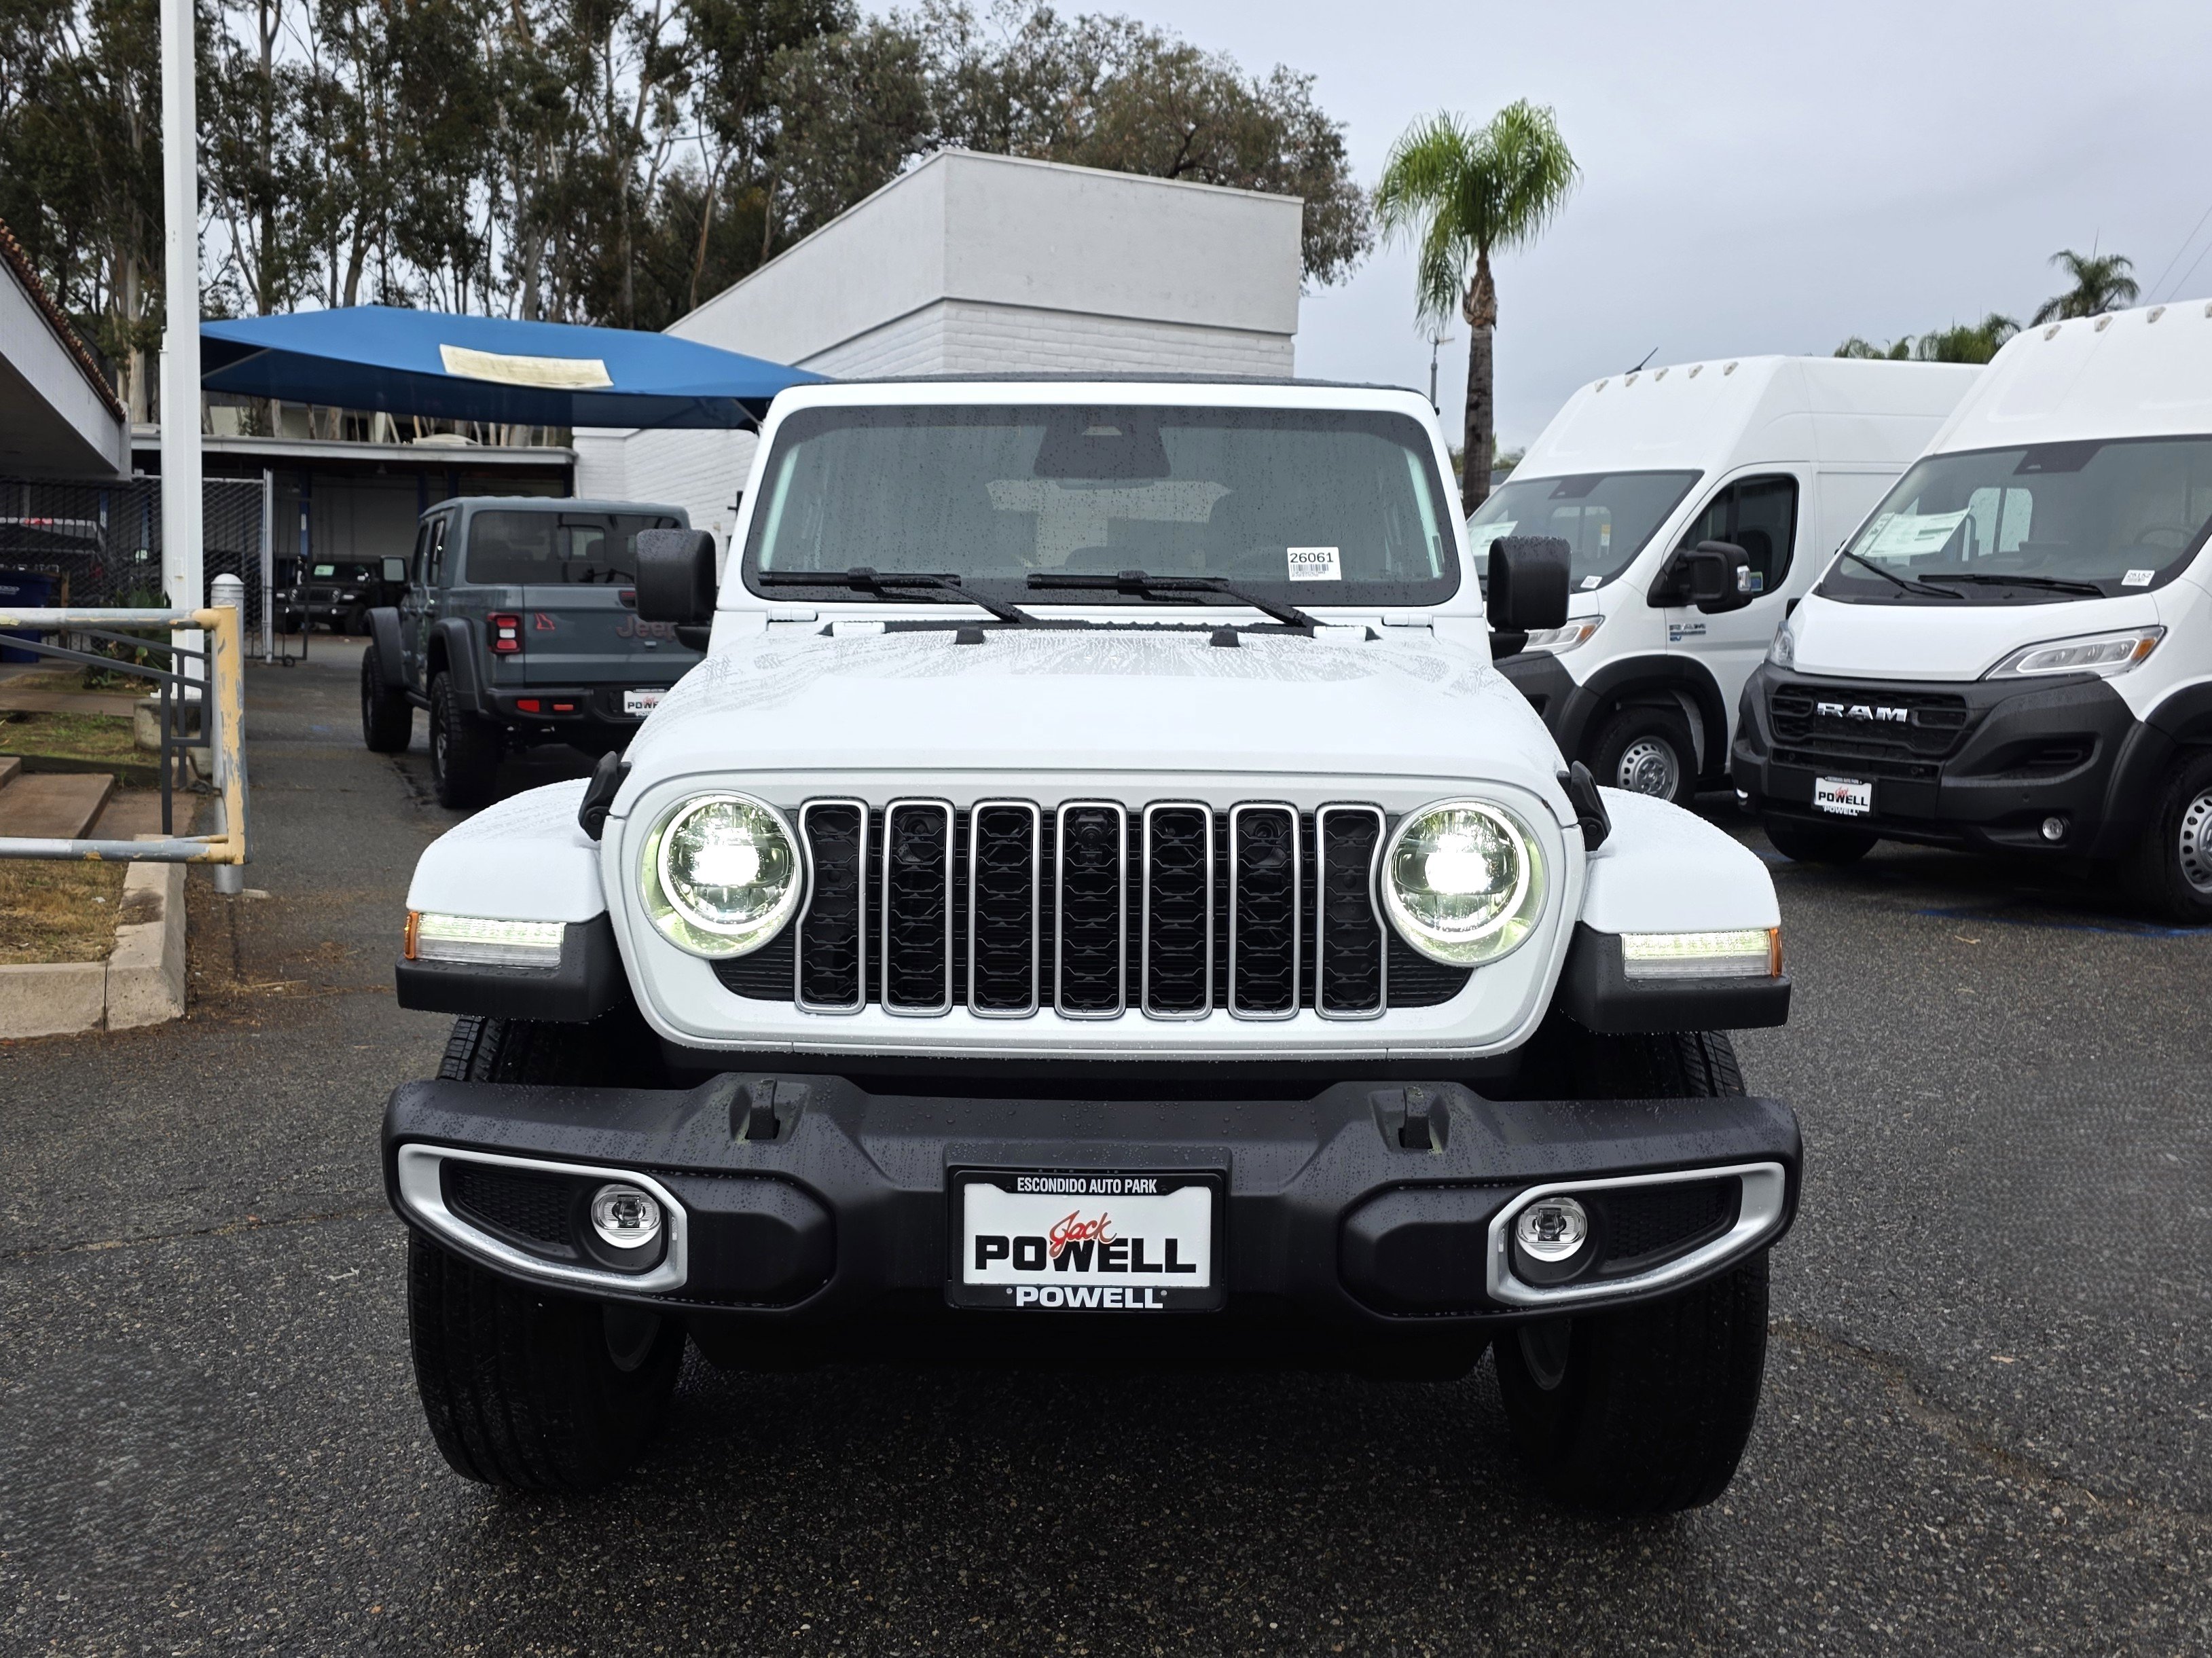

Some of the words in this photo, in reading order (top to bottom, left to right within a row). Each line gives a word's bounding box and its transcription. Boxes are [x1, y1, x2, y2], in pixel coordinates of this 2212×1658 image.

[1290, 553, 1334, 563] 26061
[1817, 702, 1908, 722] RAM
[1819, 791, 1868, 807] POWELL
[1017, 1177, 1086, 1193] ESCONDIDO
[1089, 1179, 1123, 1193] AUTO
[1125, 1179, 1157, 1194] PARK
[1049, 1210, 1117, 1259] Jack
[975, 1235, 1197, 1273] POWELL
[1016, 1287, 1163, 1308] POWELL
